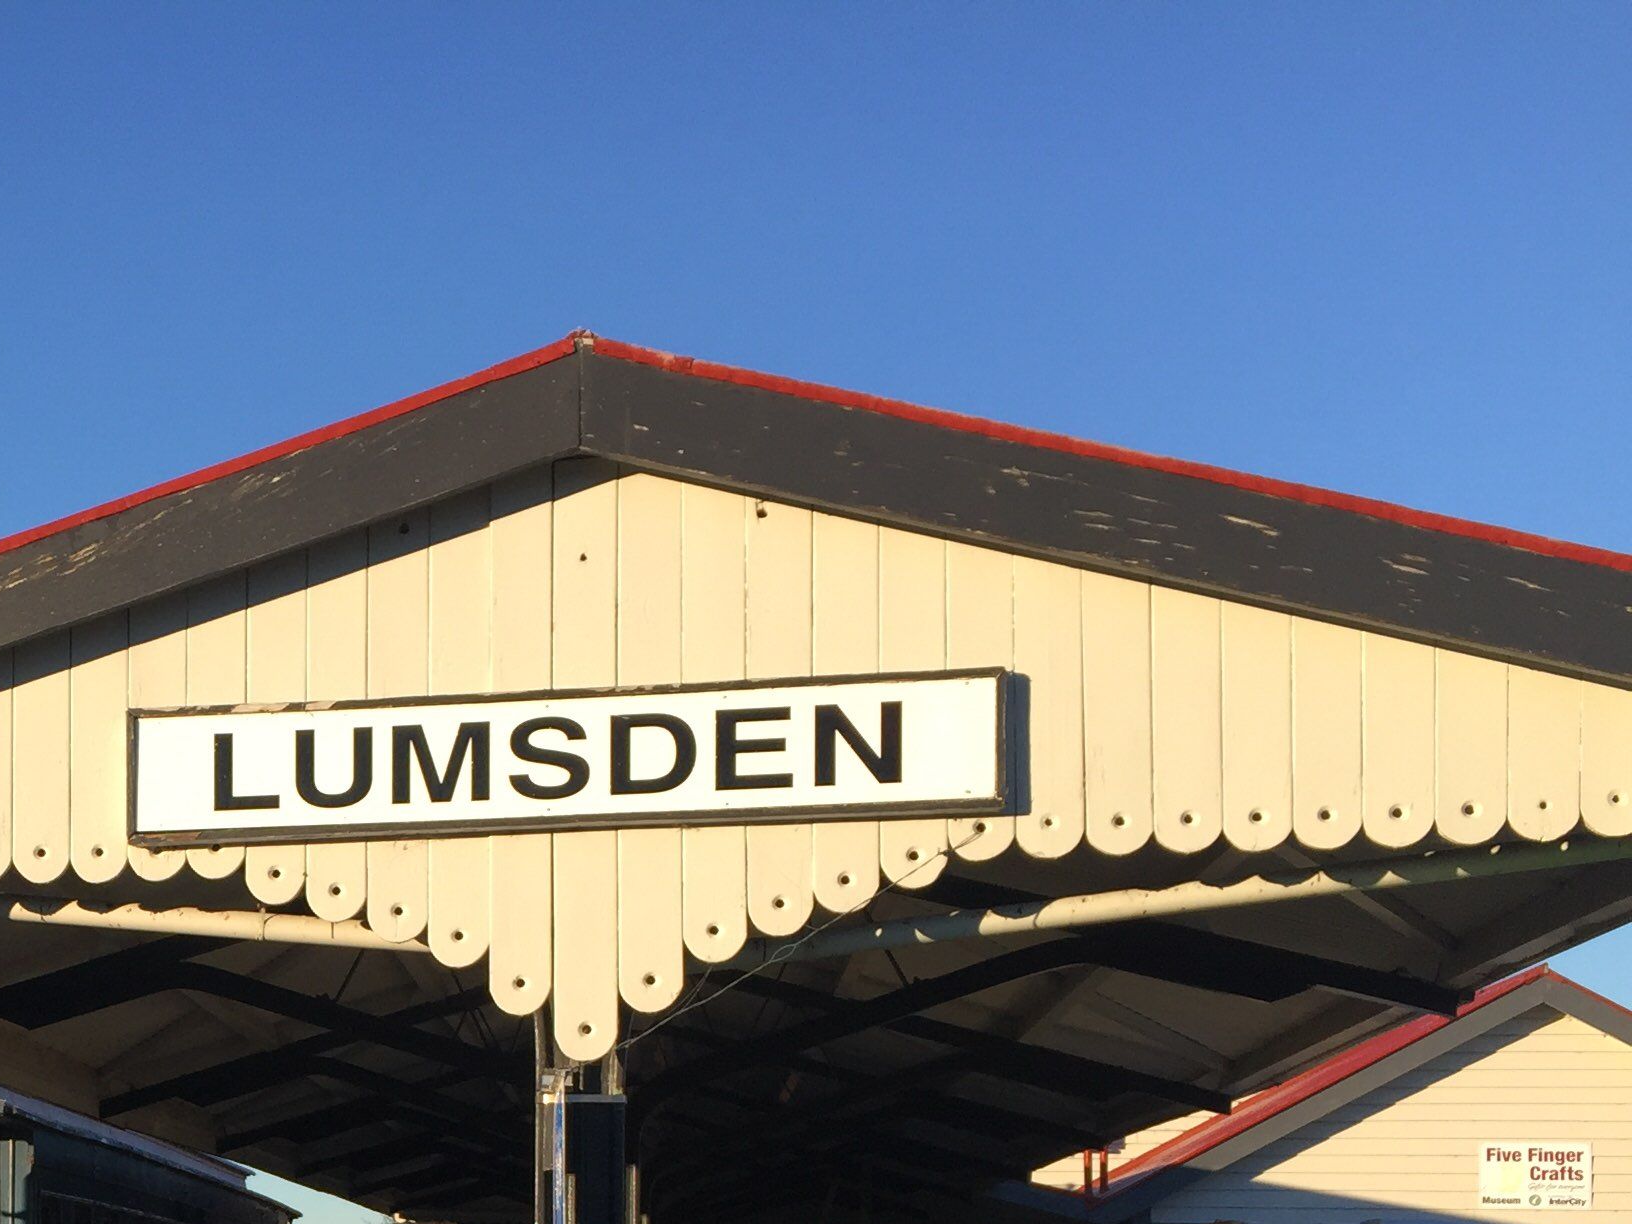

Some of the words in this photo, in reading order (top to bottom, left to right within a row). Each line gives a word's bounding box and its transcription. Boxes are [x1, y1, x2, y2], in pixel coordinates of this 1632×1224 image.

[212, 700, 903, 812] LUMSDEN
[1486, 1147, 1522, 1163] Five
[1527, 1147, 1584, 1165] Finger
[1529, 1165, 1584, 1181] Crafts
[1482, 1196, 1521, 1205] Museum
[1549, 1197, 1587, 1207] InterCity
